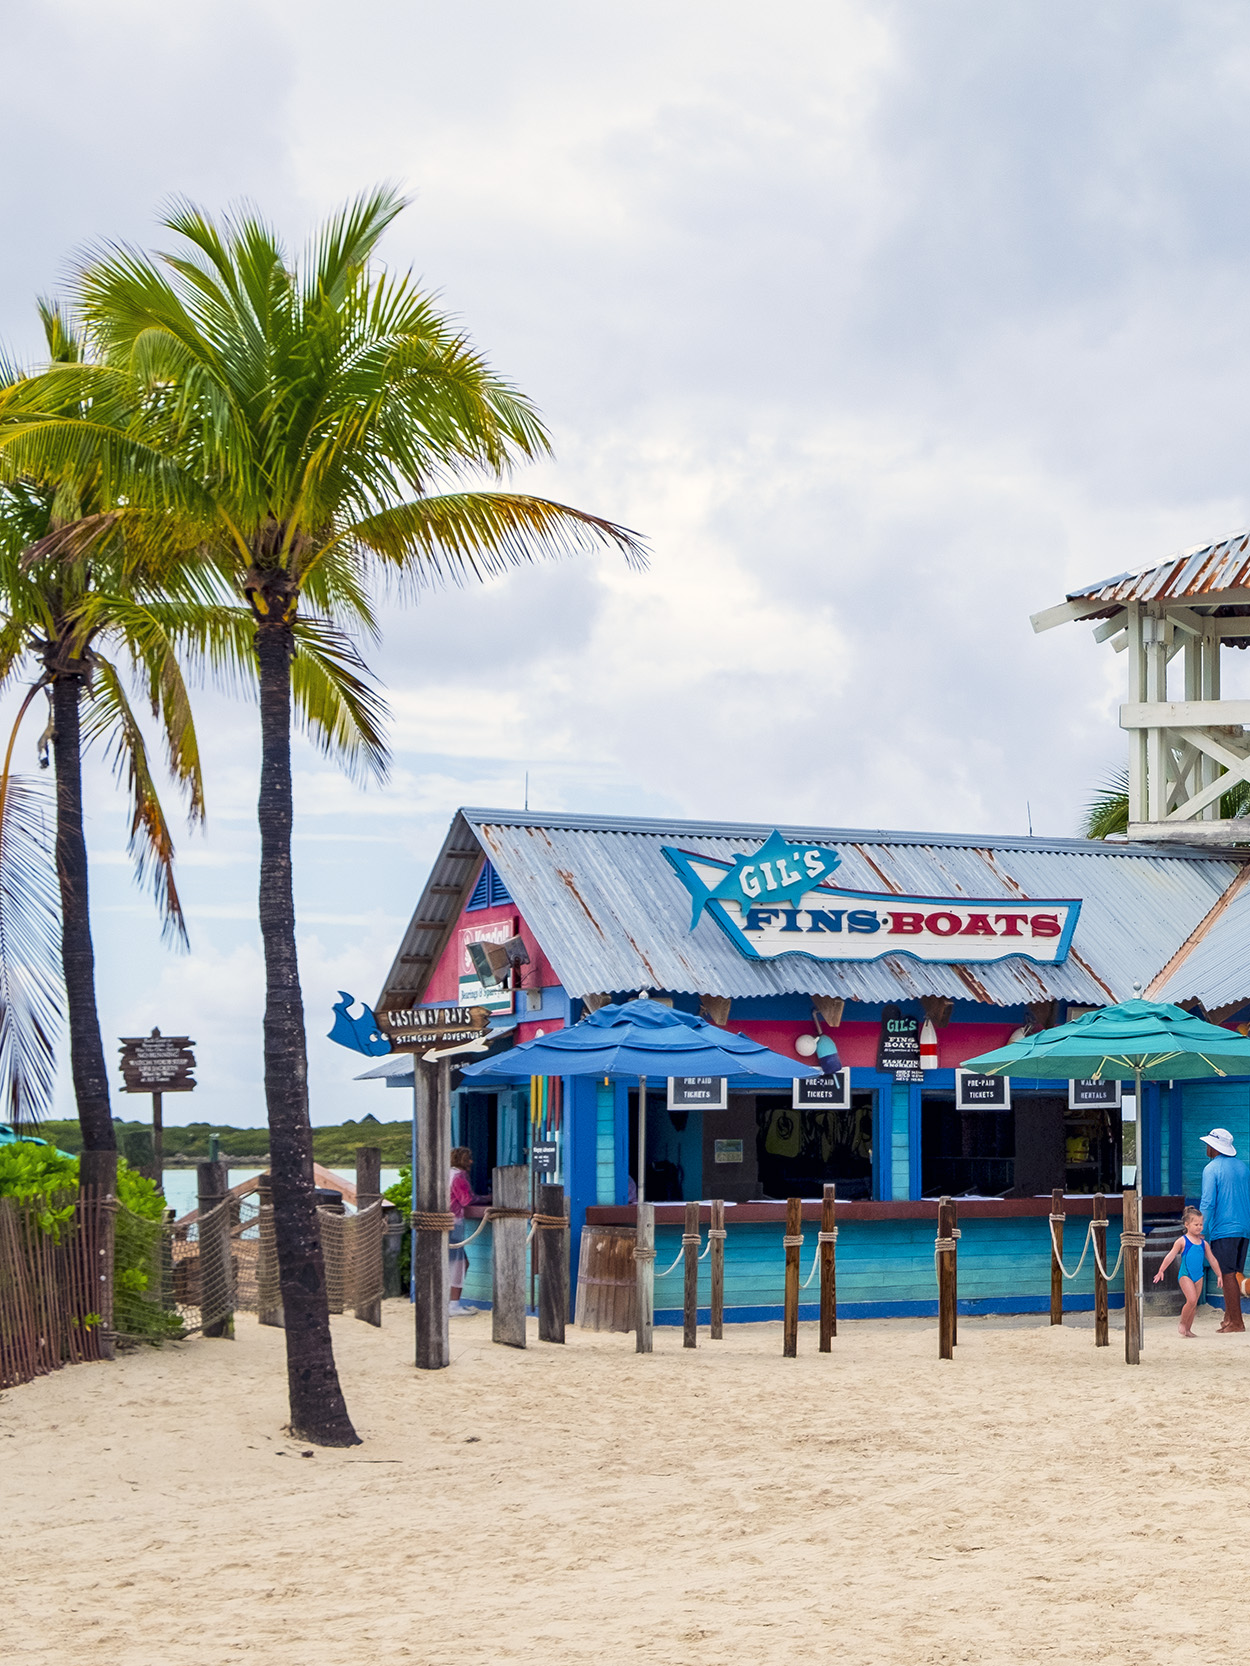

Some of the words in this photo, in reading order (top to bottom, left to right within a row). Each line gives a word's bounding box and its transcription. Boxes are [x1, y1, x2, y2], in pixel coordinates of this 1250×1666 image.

[738, 849, 826, 898] GIL'S
[741, 908, 881, 934] FINS
[887, 911, 1062, 938] BOATS
[388, 1009, 440, 1027] CASTAWAY
[444, 1008, 471, 1024] RAY'S
[886, 1018, 917, 1033] GIL'S
[396, 1034, 437, 1044] STINGRAY
[442, 1030, 483, 1041] ADVENTURE
